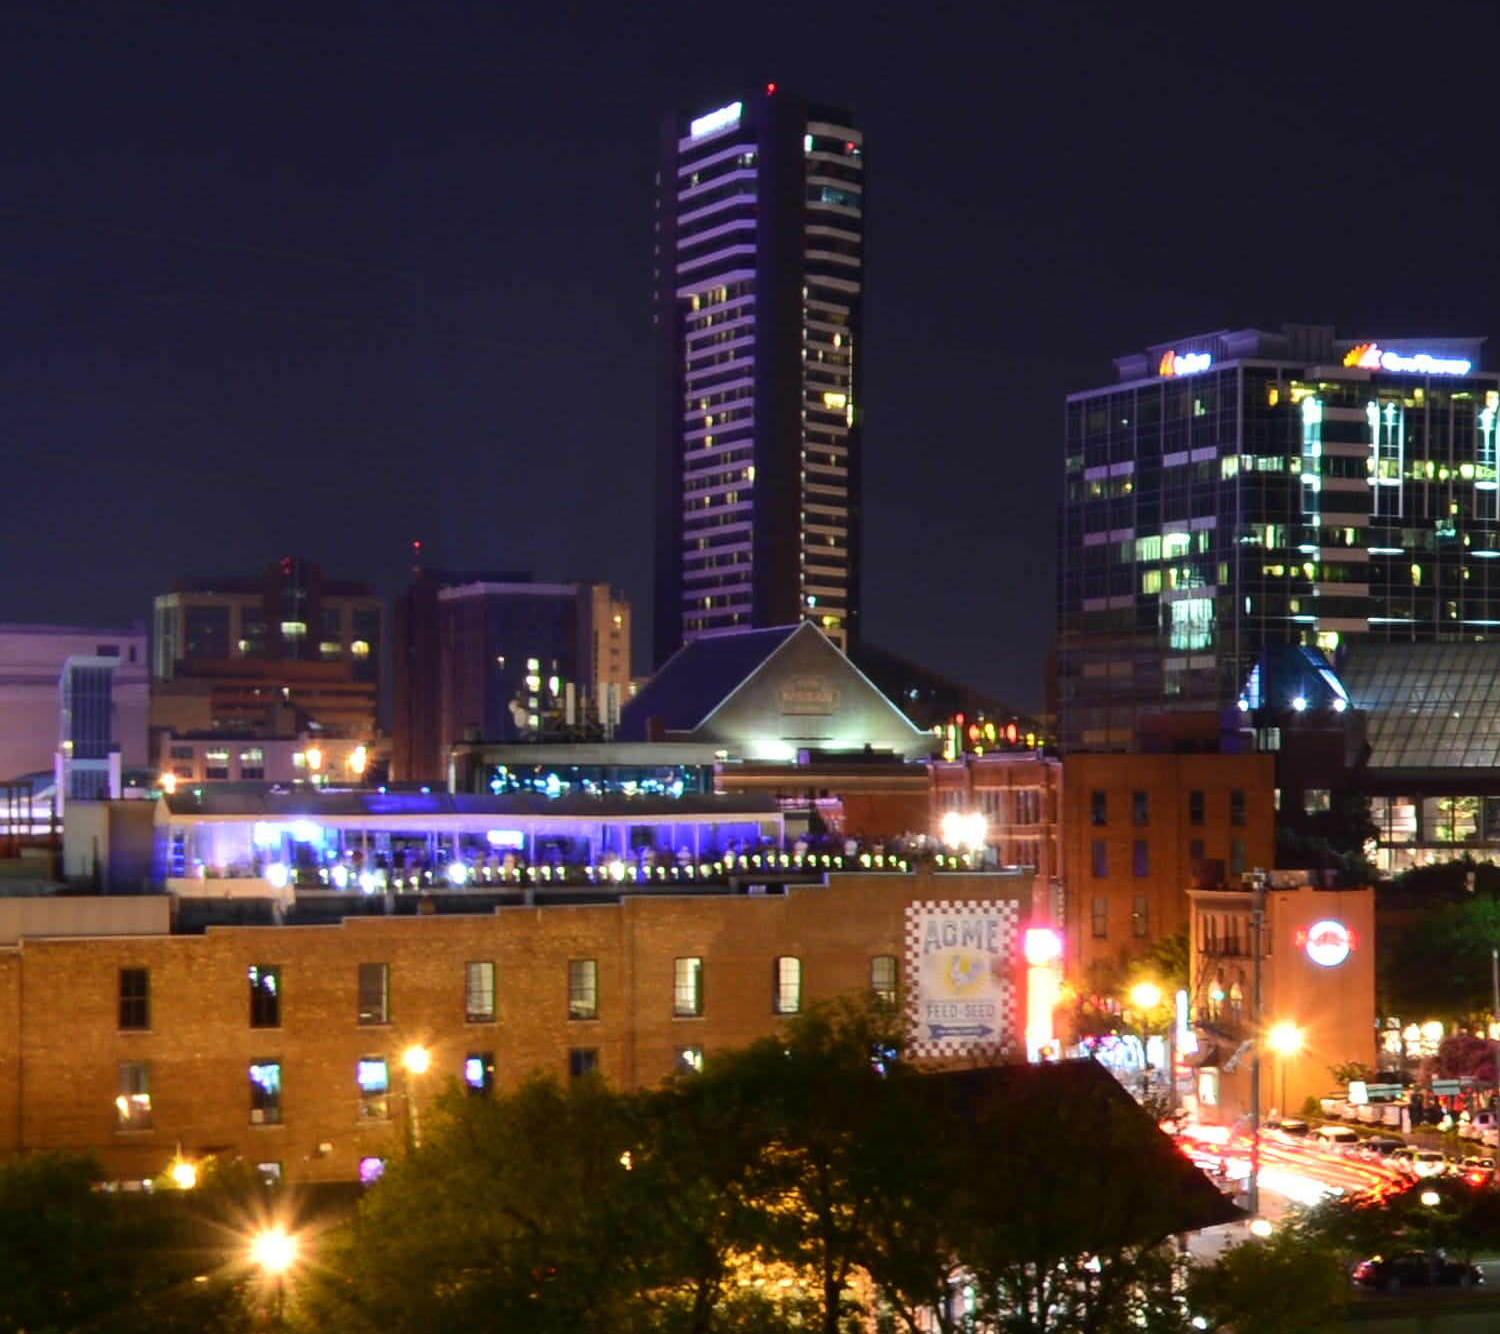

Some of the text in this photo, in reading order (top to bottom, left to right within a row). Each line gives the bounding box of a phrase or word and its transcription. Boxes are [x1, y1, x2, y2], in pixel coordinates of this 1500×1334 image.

[923, 919, 999, 954] ACME
[926, 1003, 995, 1019] FEED SEED
